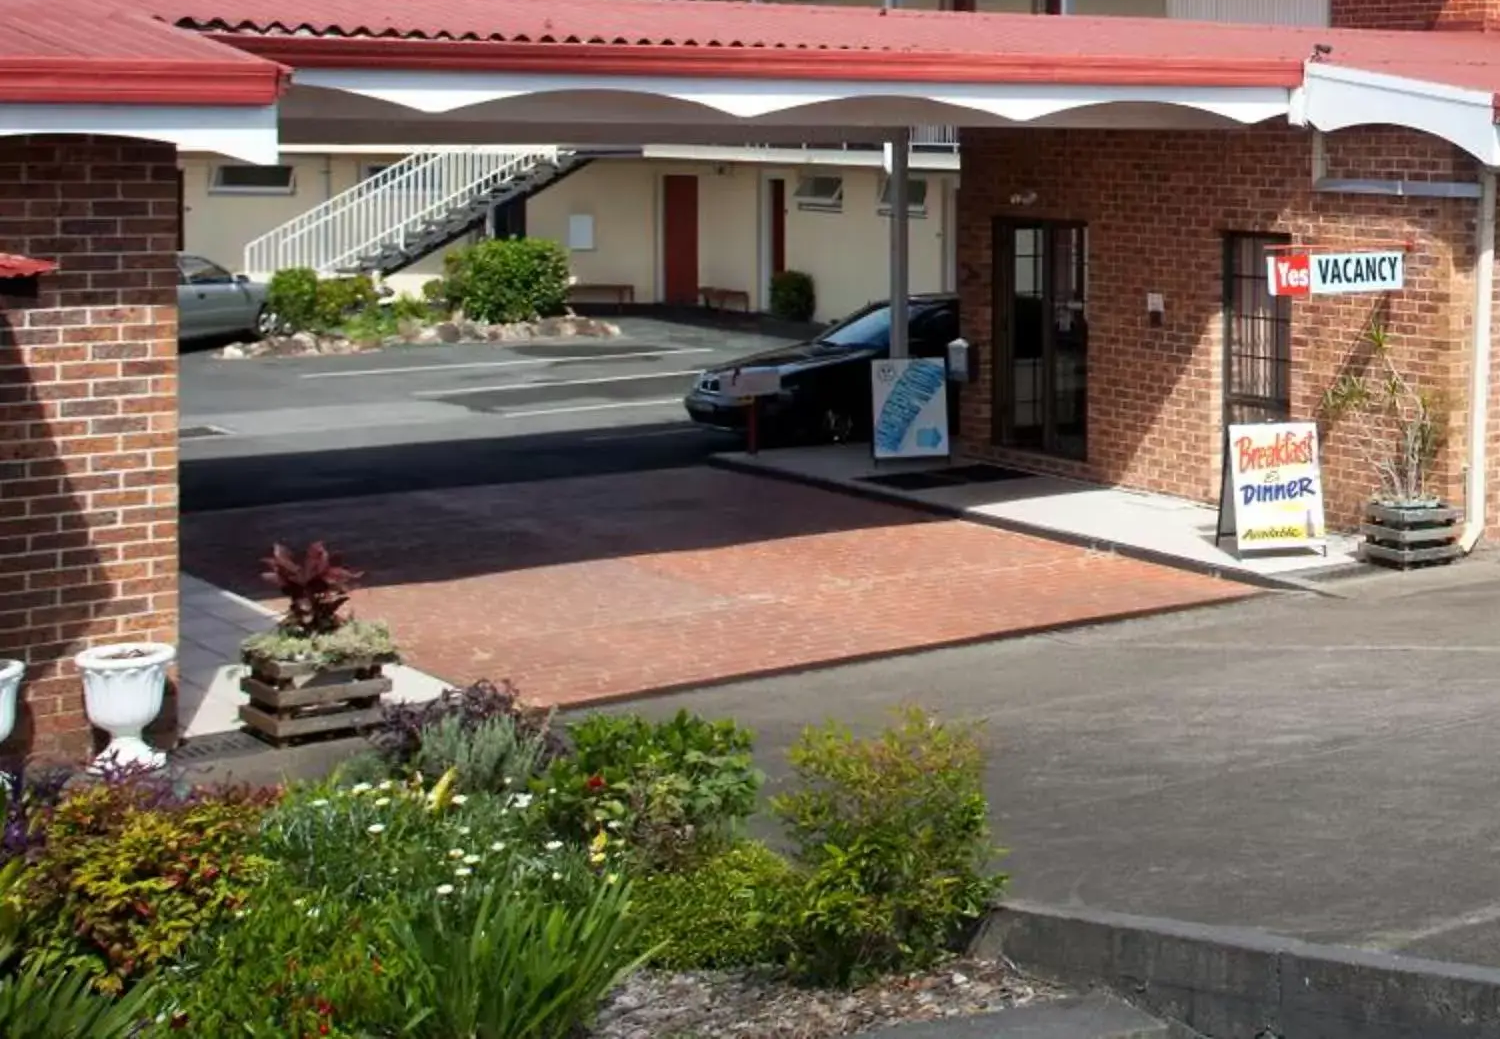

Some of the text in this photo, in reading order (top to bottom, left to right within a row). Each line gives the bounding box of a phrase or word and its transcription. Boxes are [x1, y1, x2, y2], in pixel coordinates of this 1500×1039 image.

[1278, 257, 1398, 287] Yes VACANCY
[1235, 431, 1314, 473] Breakfast
